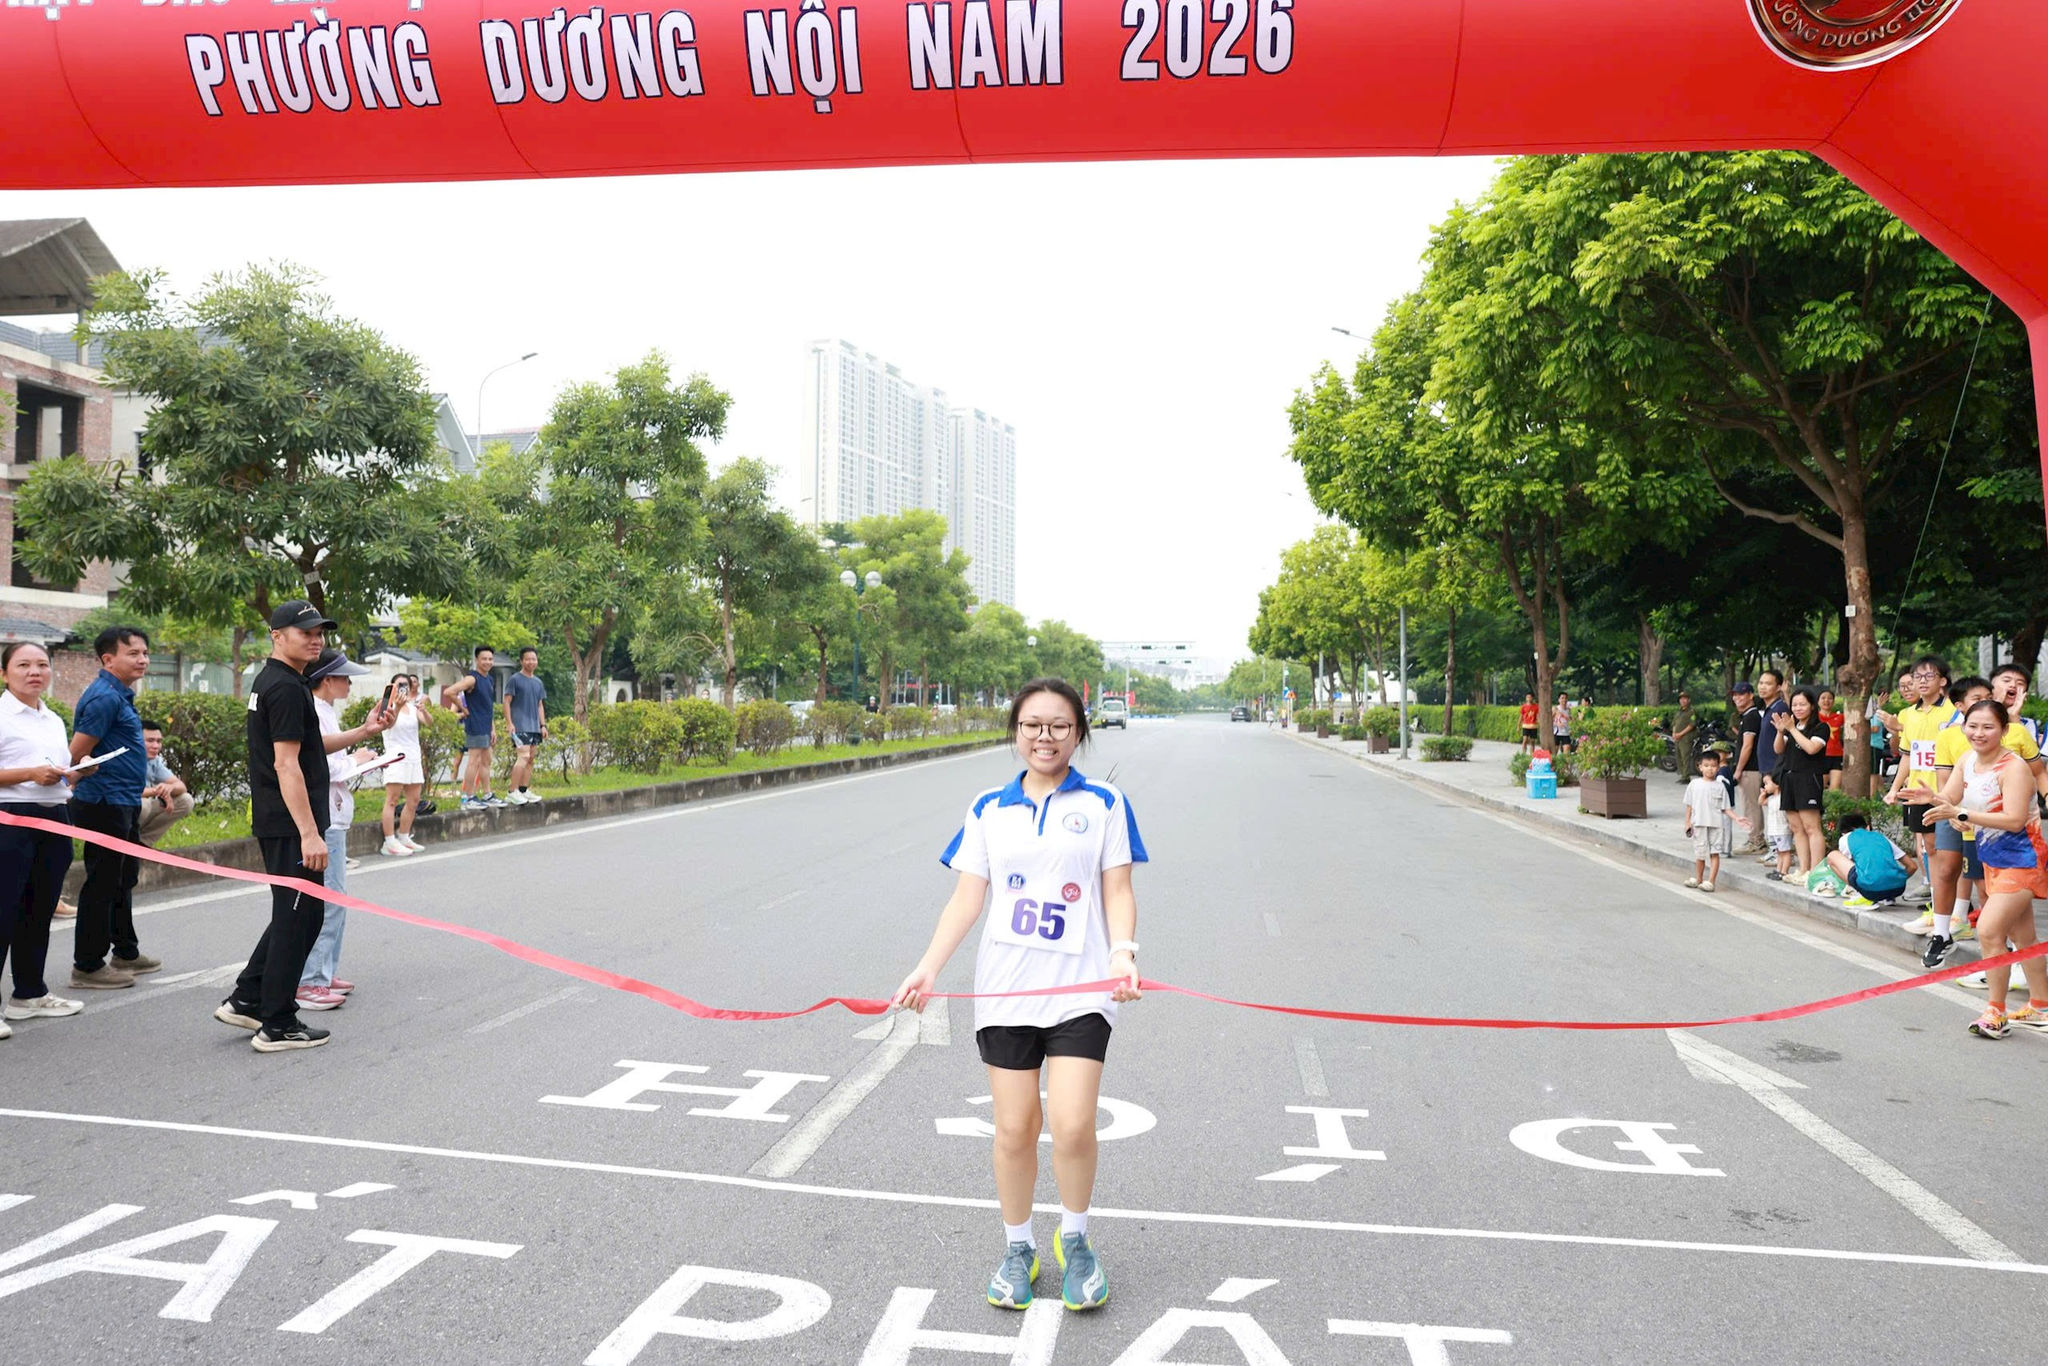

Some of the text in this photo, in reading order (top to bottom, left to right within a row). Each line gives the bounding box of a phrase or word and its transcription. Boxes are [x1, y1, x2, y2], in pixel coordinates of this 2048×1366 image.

[184, 0, 1294, 116] PHƯỜNG DƯƠNG NỘI NAM 2026
[1916, 751, 1936, 767] 15
[1010, 898, 1067, 941] 65
